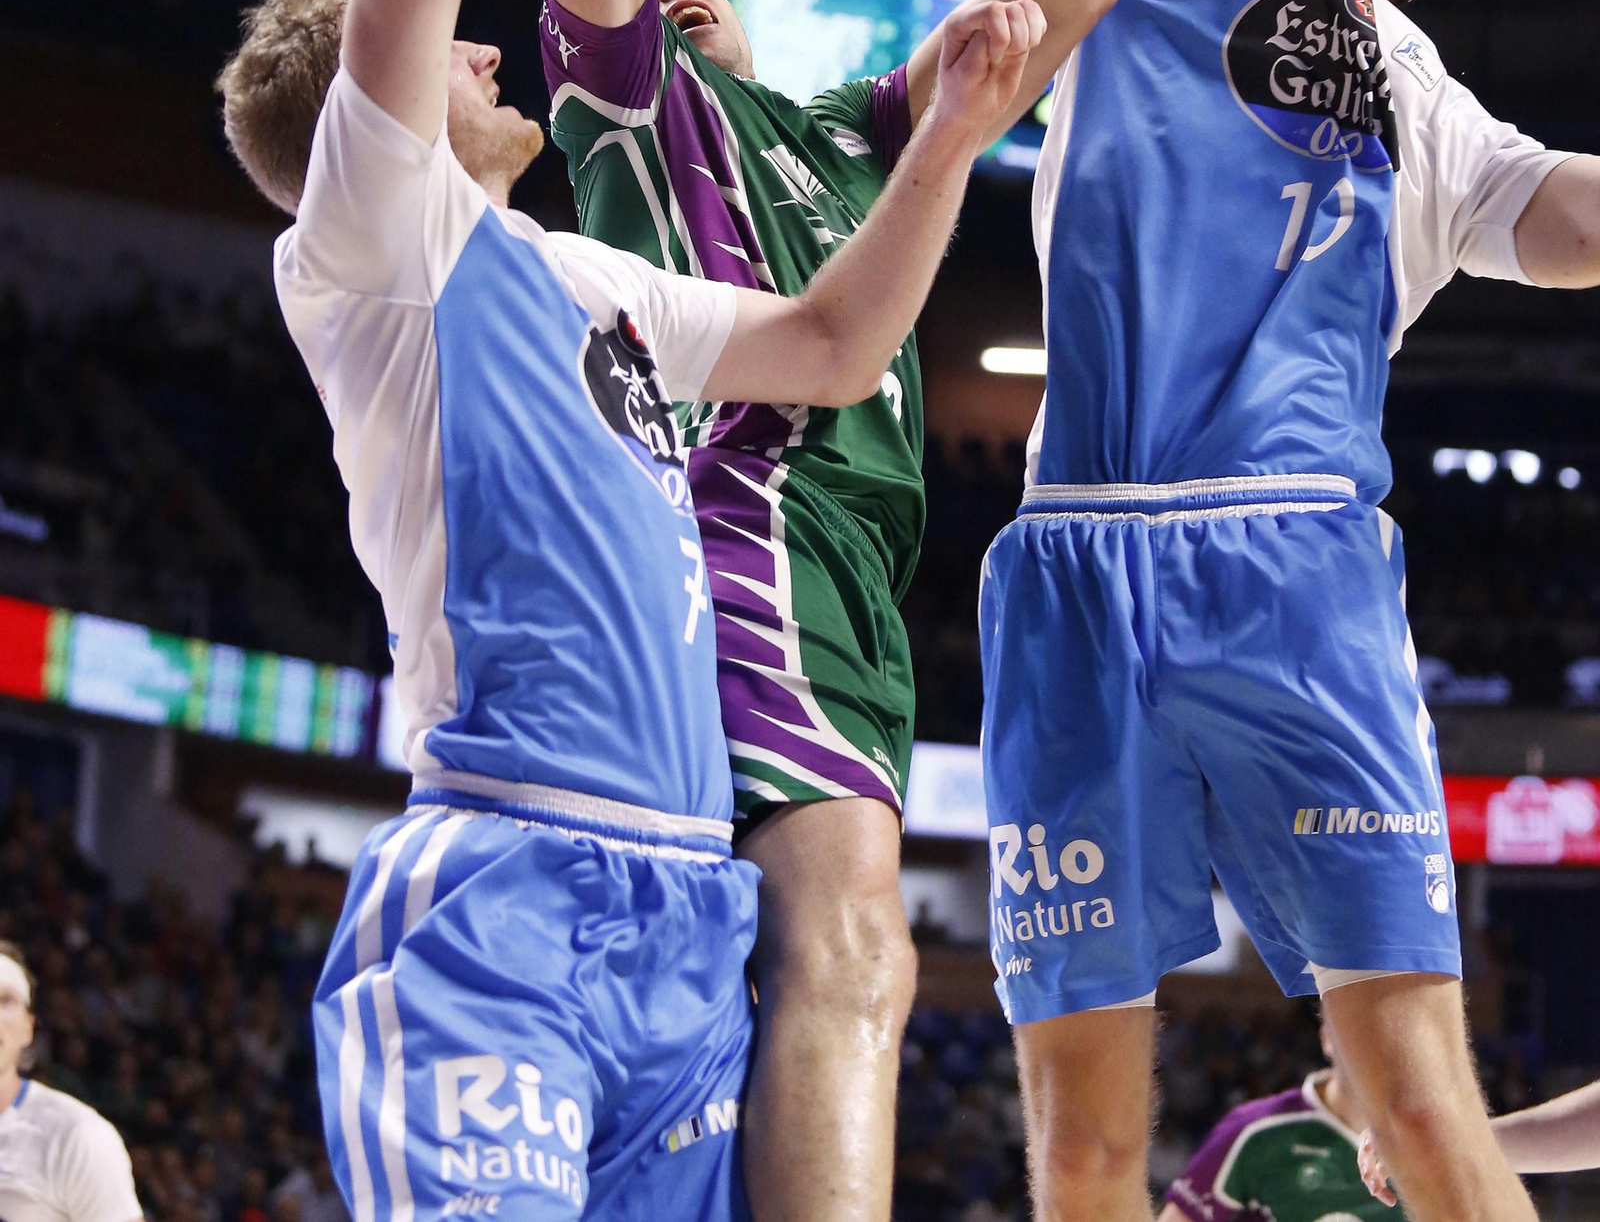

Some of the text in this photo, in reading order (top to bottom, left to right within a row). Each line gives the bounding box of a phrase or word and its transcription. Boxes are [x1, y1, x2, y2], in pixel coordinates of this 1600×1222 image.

[679, 535, 707, 645] 7
[989, 823, 1105, 898] Rio
[997, 897, 1115, 944] Natura
[435, 1055, 583, 1152] Rio
[440, 1139, 583, 1208] Natura
